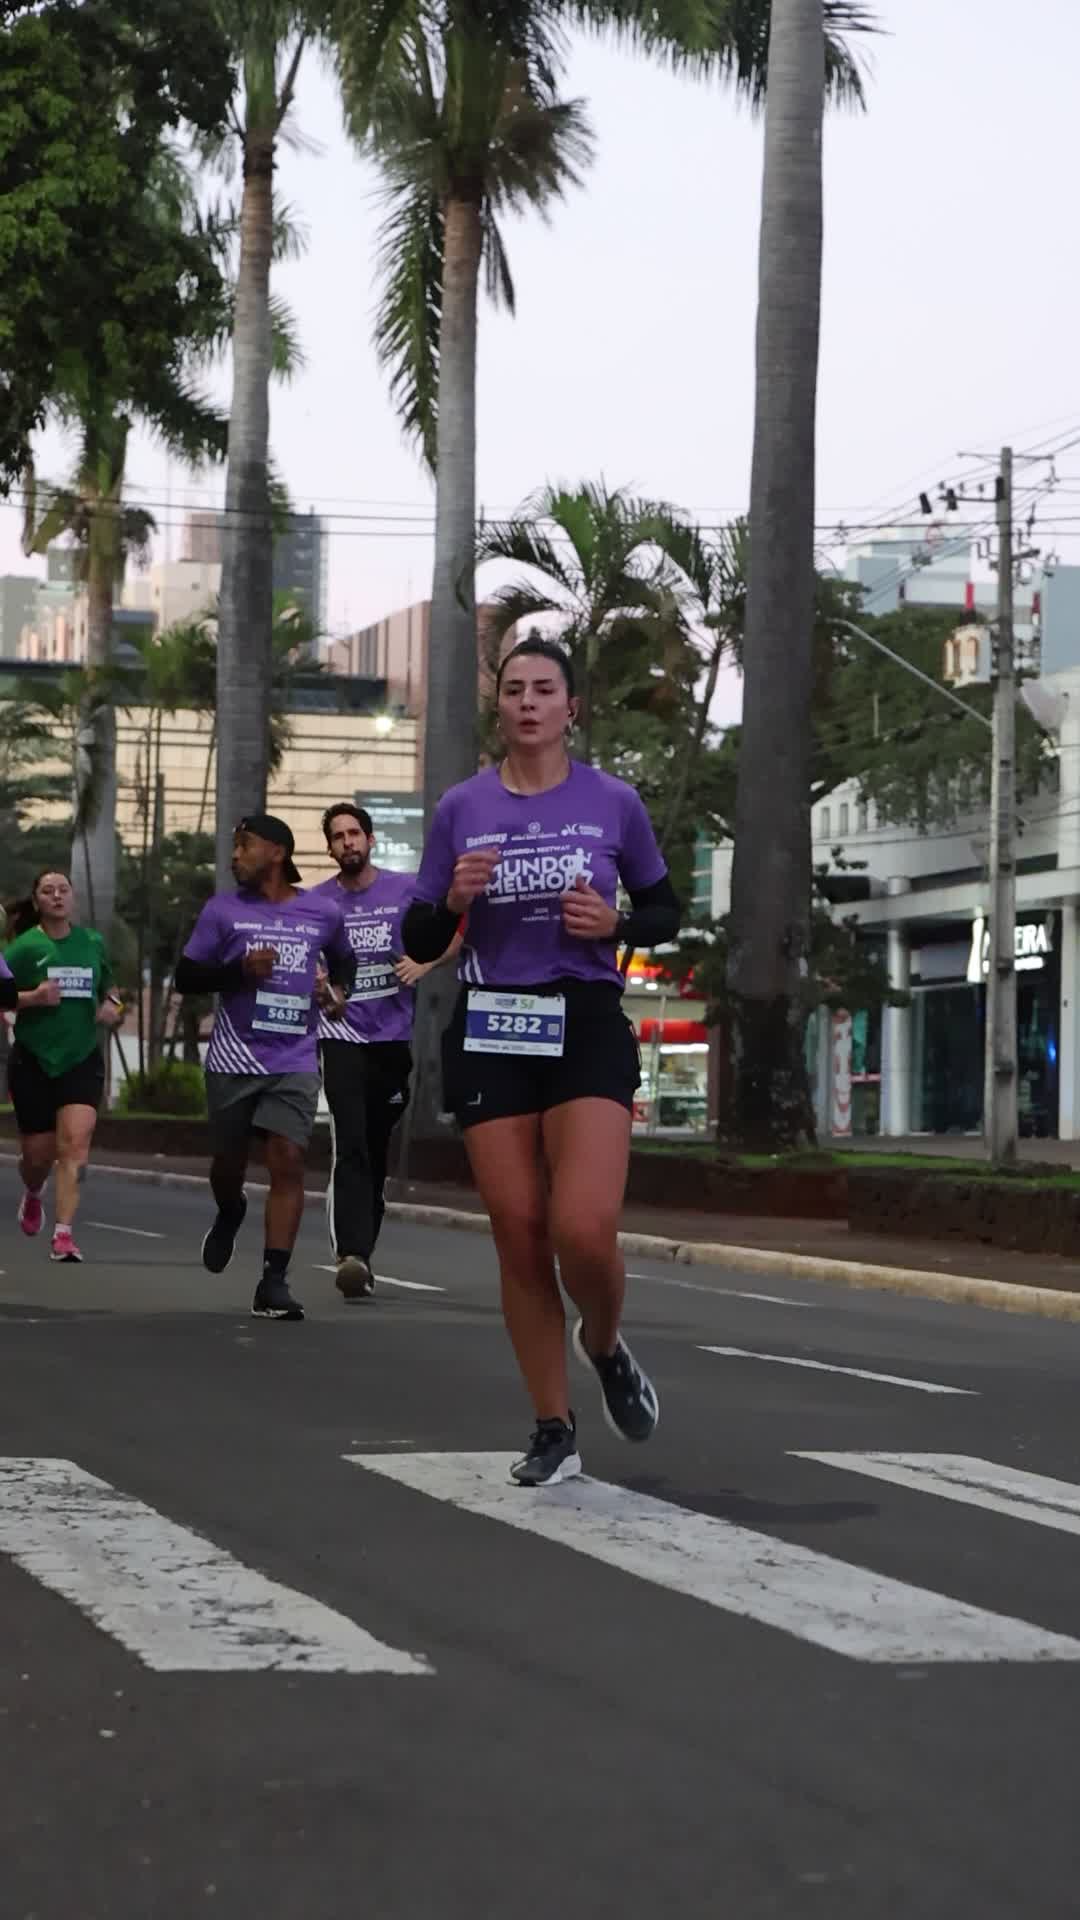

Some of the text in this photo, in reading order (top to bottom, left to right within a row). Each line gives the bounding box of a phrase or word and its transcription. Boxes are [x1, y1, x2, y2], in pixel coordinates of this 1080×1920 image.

[355, 976, 387, 989] 5018
[268, 1008, 300, 1021] 5635
[487, 1014, 541, 1034] 5282
